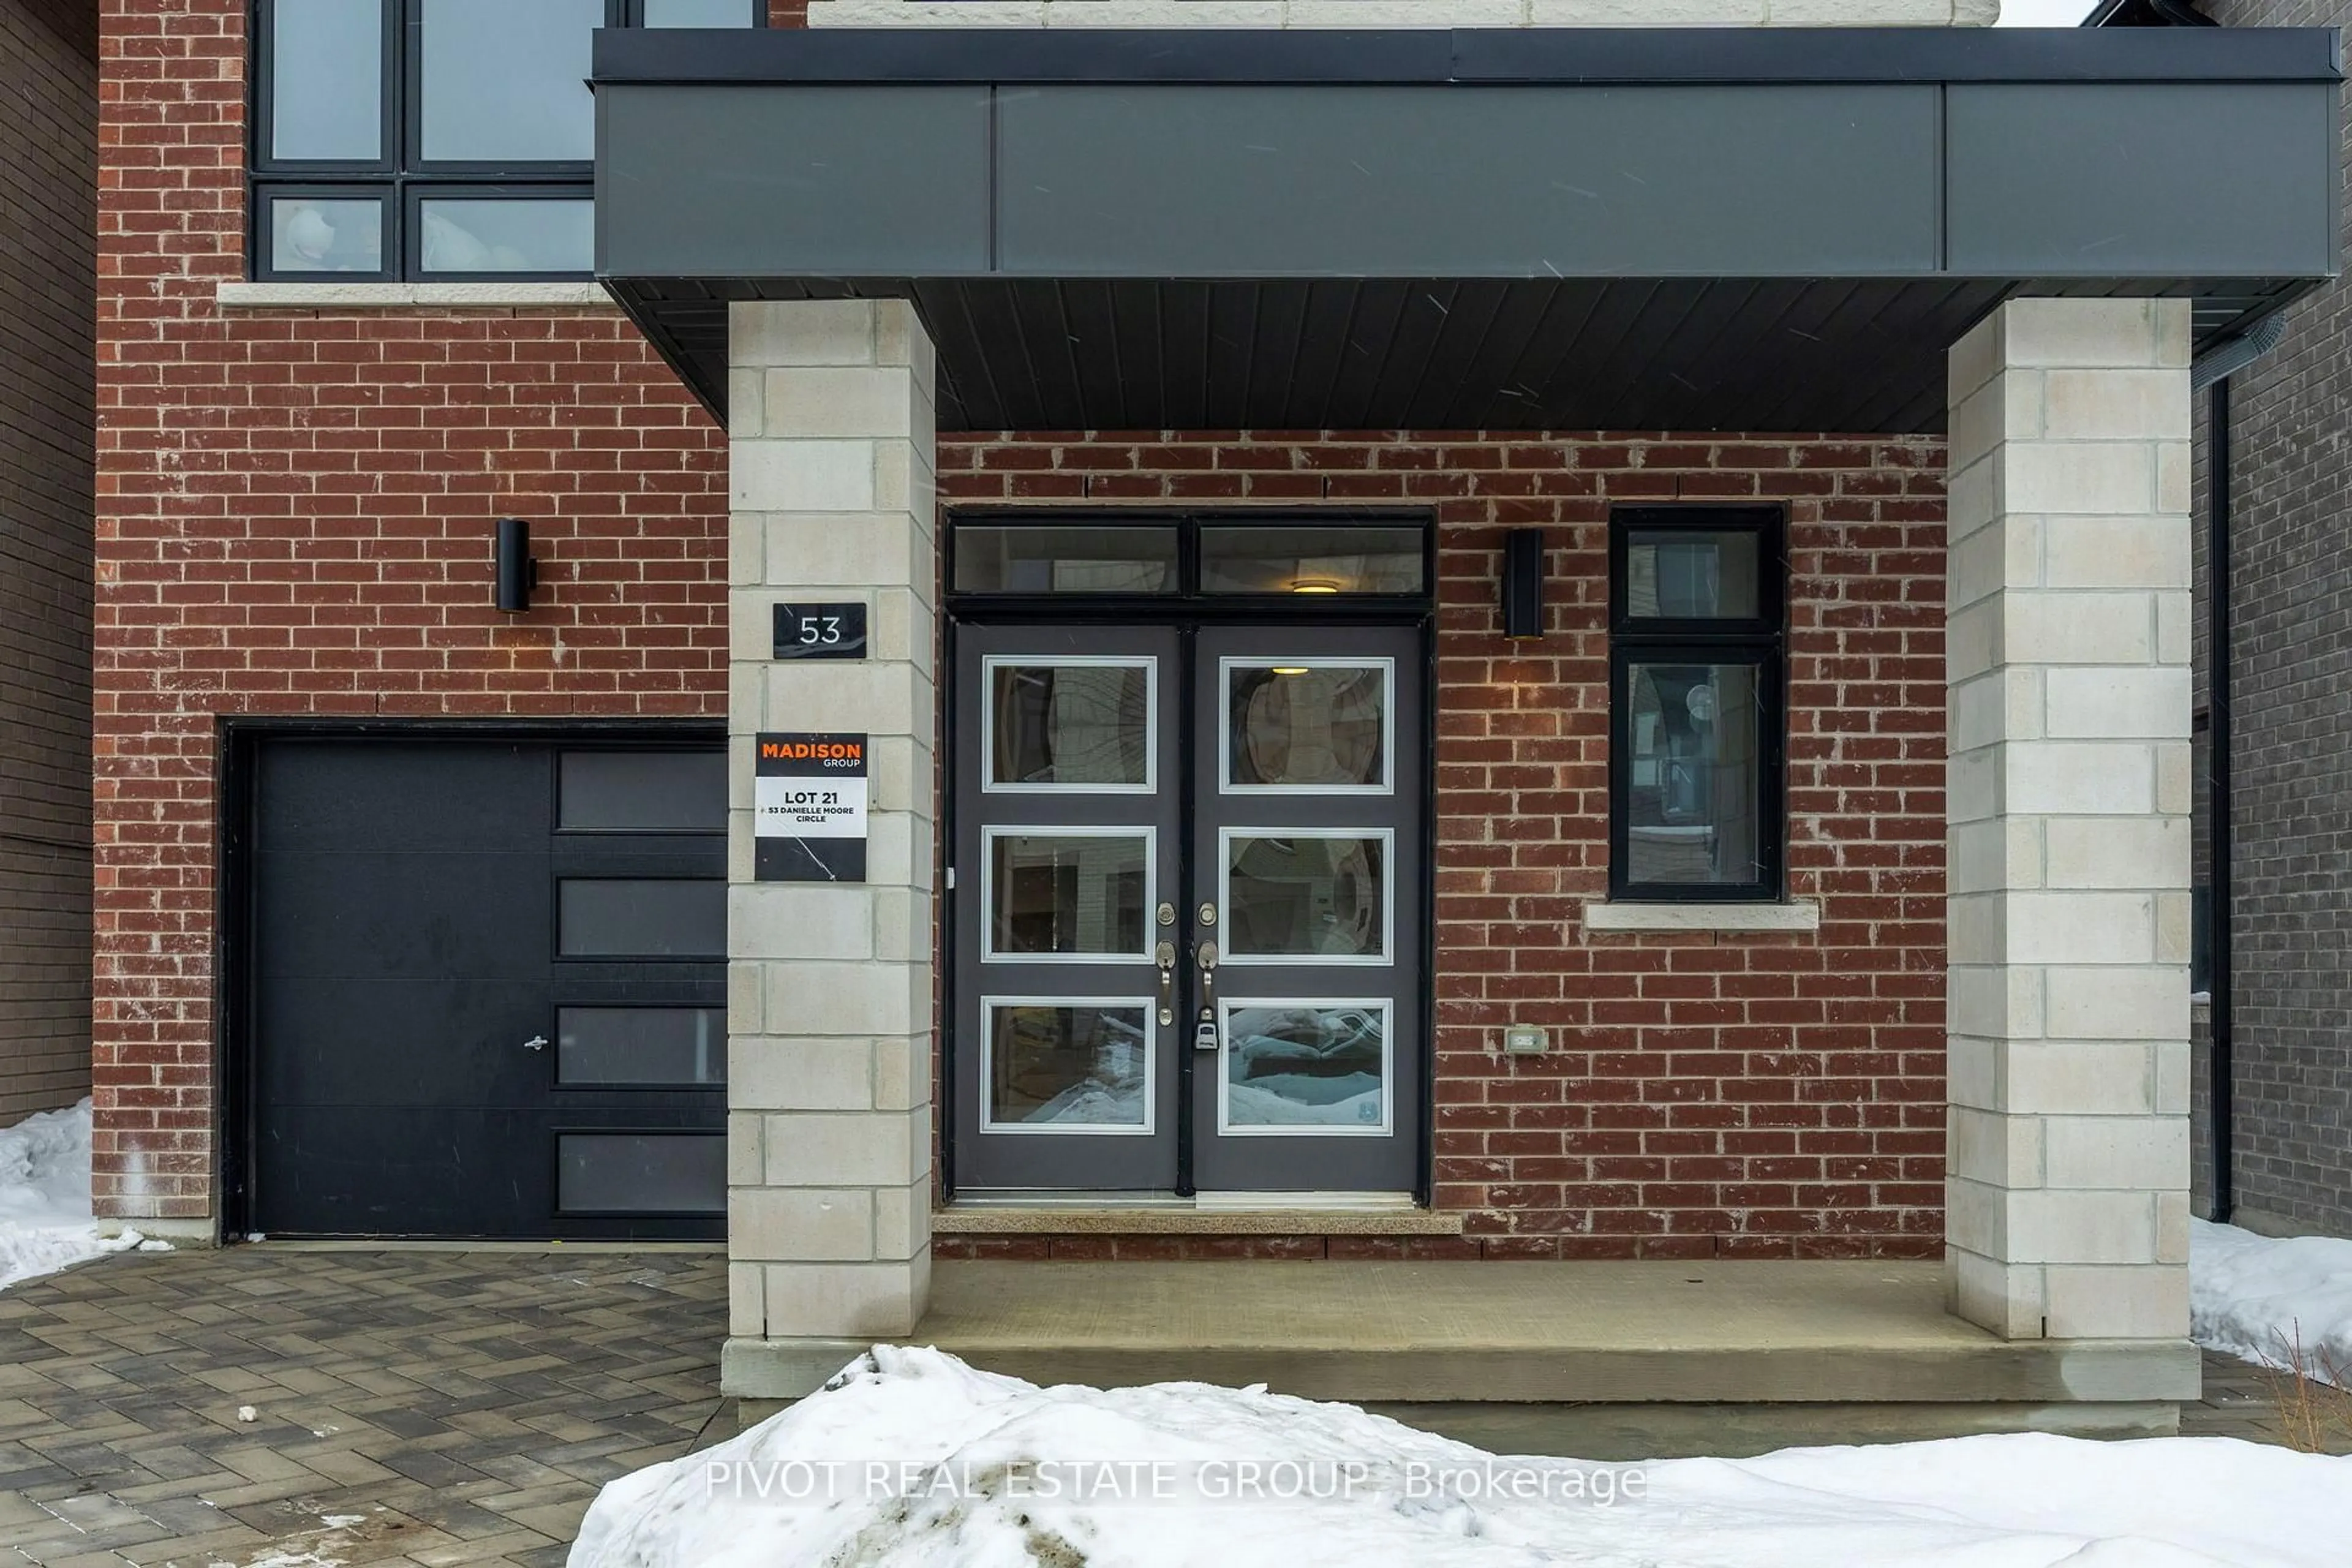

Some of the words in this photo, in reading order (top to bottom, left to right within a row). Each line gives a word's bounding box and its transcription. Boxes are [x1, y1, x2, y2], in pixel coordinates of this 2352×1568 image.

[800, 617, 840, 644] 53
[763, 743, 861, 758] MADISON
[823, 759, 861, 767] GROUP
[785, 792, 818, 804] LOT
[821, 792, 838, 804] 21
